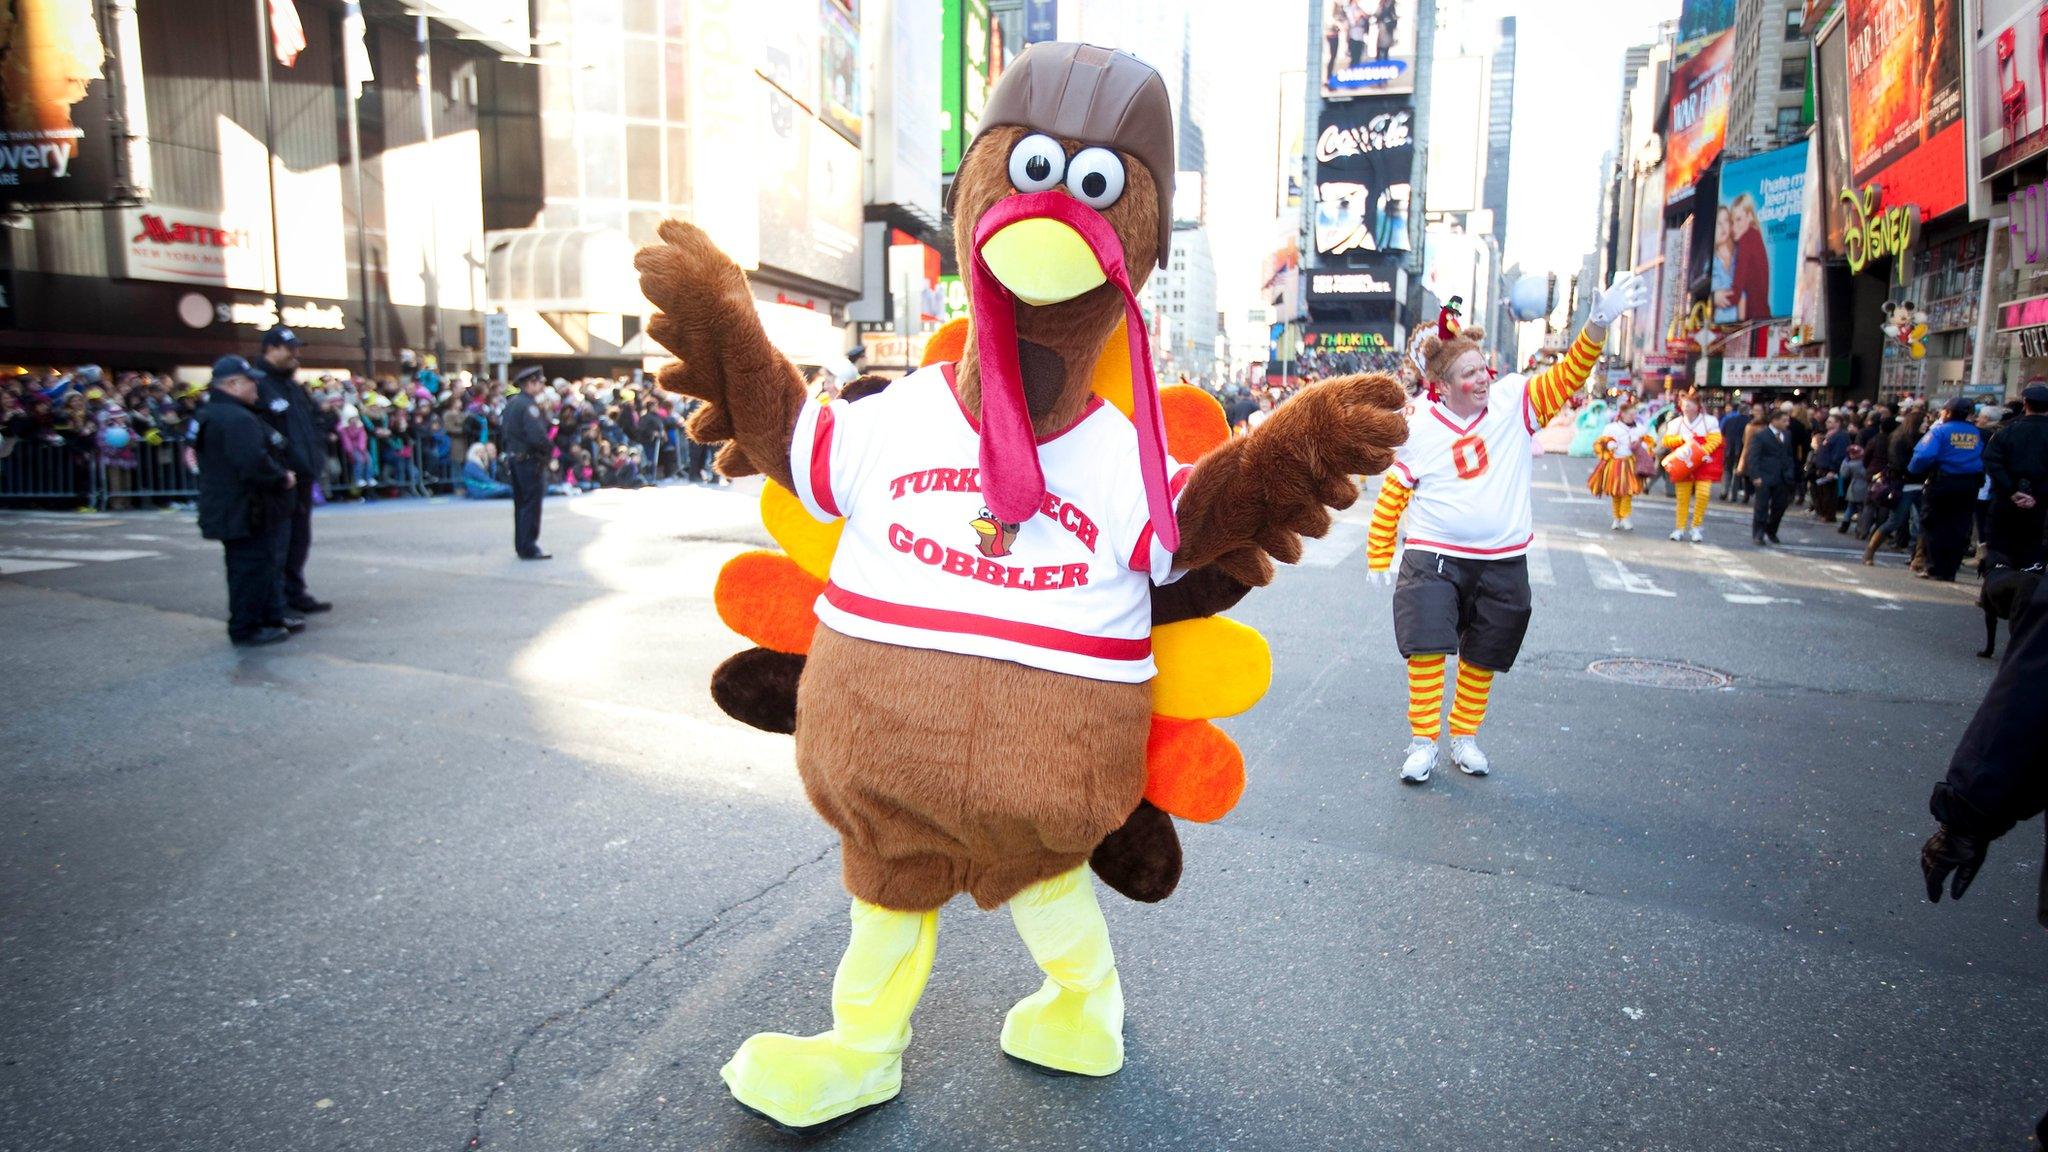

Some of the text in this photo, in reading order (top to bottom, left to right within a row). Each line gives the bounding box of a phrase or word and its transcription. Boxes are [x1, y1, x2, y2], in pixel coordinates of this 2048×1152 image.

[1673, 91, 1697, 132] WAR
[888, 466, 1100, 554] TURK ECH
[887, 521, 1090, 592] GOBBLER
